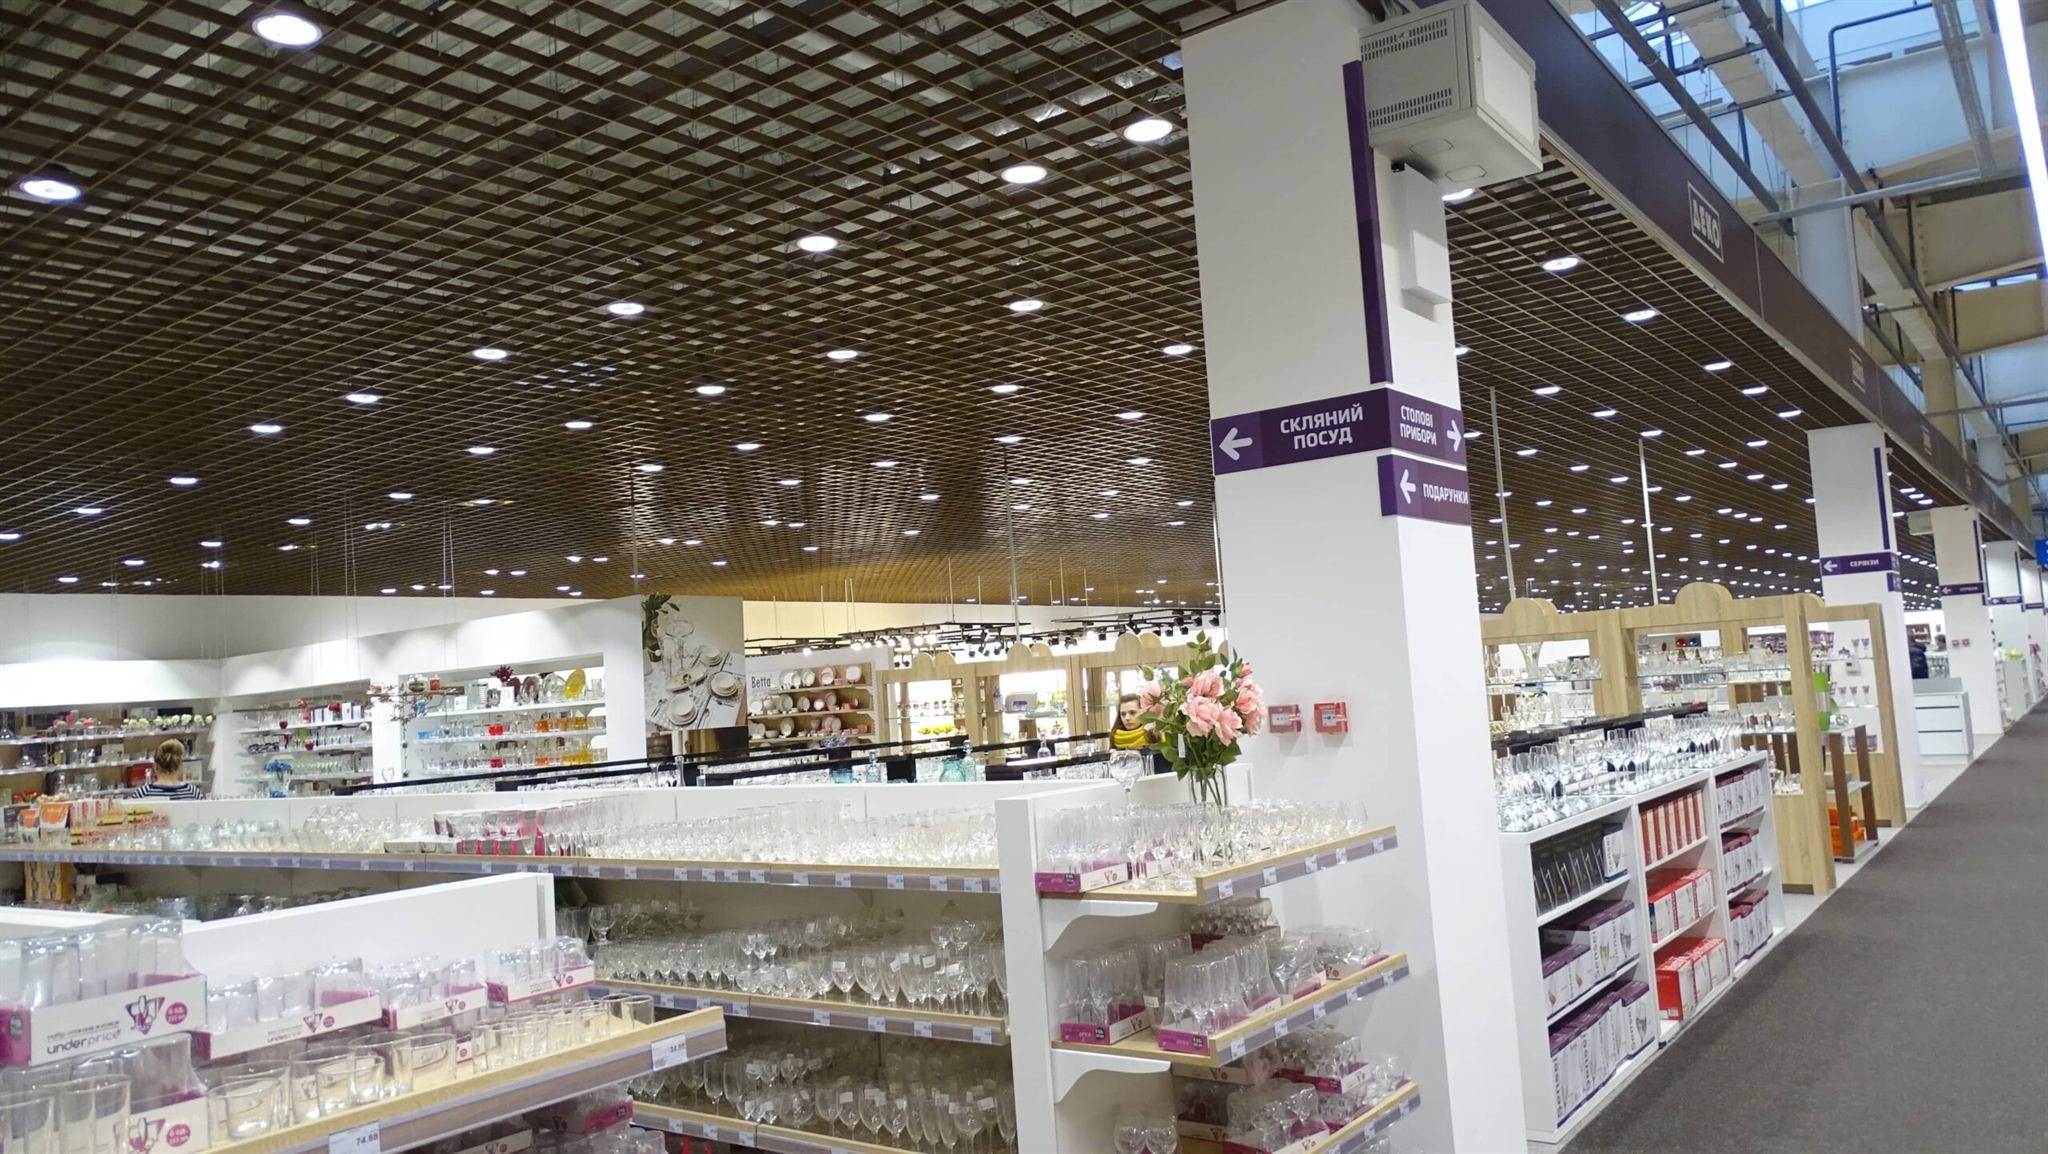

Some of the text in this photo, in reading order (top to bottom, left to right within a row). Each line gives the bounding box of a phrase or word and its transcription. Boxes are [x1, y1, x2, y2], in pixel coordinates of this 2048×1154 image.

[1280, 403, 1363, 434] СКЛЯНИЙ
[1400, 405, 1434, 428] СТОЛОВІ
[1293, 422, 1353, 450] ПОСУД
[1400, 423, 1437, 446] ПРИБОРИ
[1423, 483, 1469, 504] ПОДАРУНКИ
[751, 676, 771, 688] Betta
